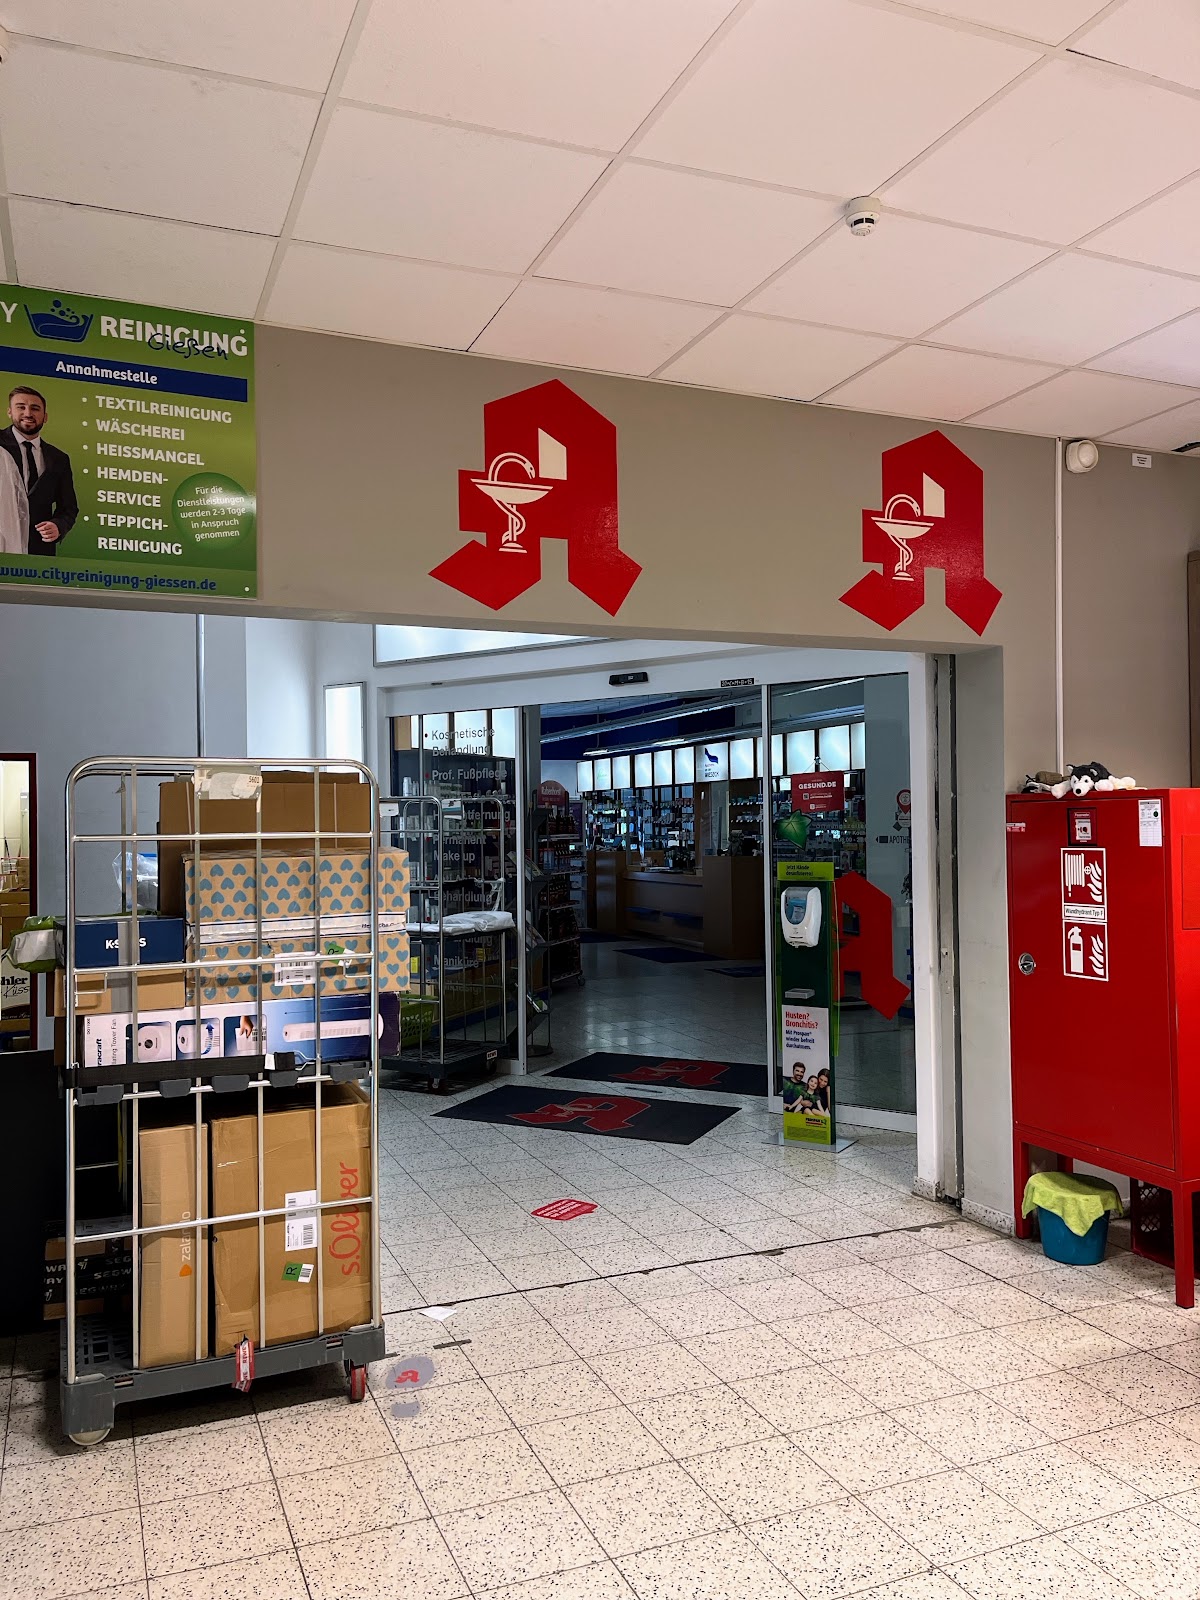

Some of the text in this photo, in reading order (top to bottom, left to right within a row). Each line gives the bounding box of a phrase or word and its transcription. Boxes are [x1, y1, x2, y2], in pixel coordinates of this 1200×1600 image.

[100, 316, 248, 357] REINIGUNG
[148, 333, 228, 360] Gießen
[56, 361, 158, 385] Annahmestelle
[95, 395, 232, 423] TEXTILREINIGUNG
[96, 418, 185, 441] WÄSCHEREI
[96, 443, 205, 466] HEISSMANGEL
[97, 466, 168, 485] HEMDEN-
[195, 487, 209, 495] Für
[97, 490, 161, 507] SERVICE
[177, 496, 245, 507] Dienstleistungen
[180, 507, 246, 518] werden 2-3 Tage
[97, 513, 168, 531] TEPPICH-
[191, 518, 239, 529] in Anspruch
[195, 530, 240, 542] genommen
[97, 537, 182, 555] REINIGUNG
[0, 566, 217, 590] www.cityreinigung-giessen.de
[431, 727, 495, 740] Kosmetische
[432, 744, 491, 757] Behandlung
[432, 768, 507, 781] Prof. Fußpflege
[798, 781, 837, 790] GESUND.DE
[463, 853, 475, 864] up
[785, 1011, 810, 1020] Husten?
[785, 1020, 819, 1029] Bronchitis?
